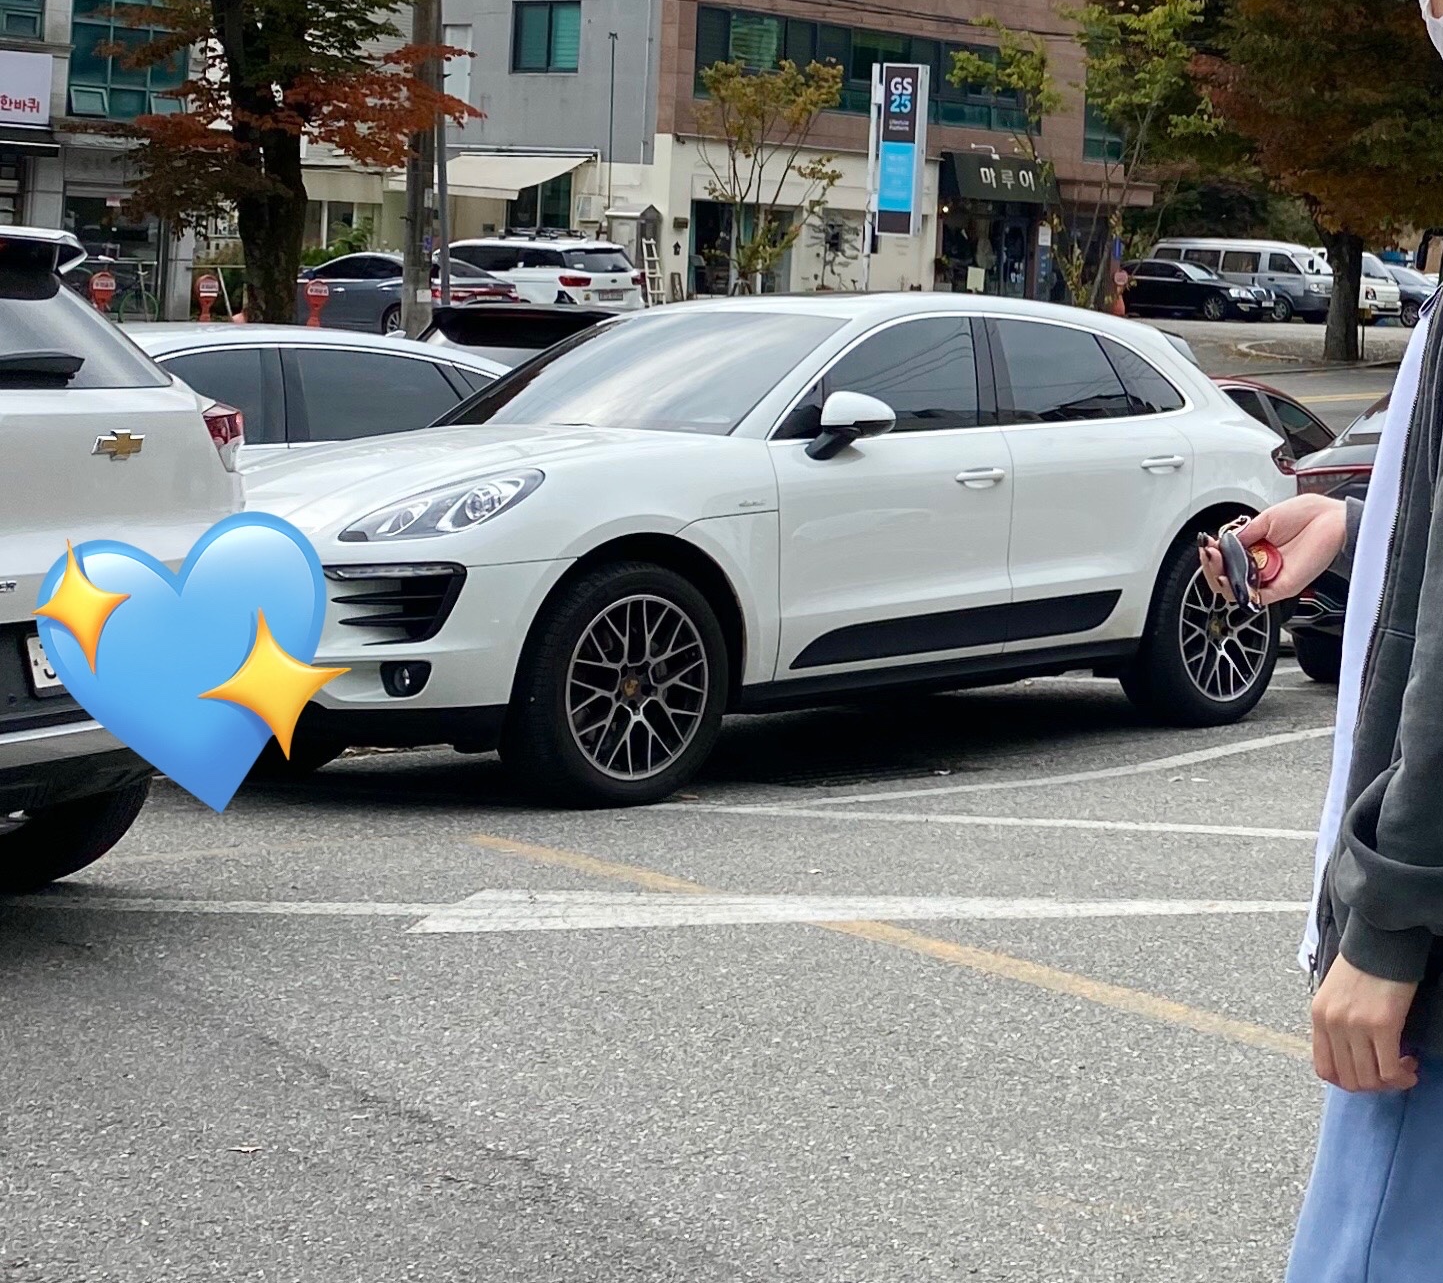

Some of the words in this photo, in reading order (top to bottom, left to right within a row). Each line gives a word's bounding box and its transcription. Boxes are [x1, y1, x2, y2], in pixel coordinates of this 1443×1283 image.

[890, 77, 913, 95] GS
[0, 94, 40, 113] 한바퀴
[889, 95, 912, 113] 25
